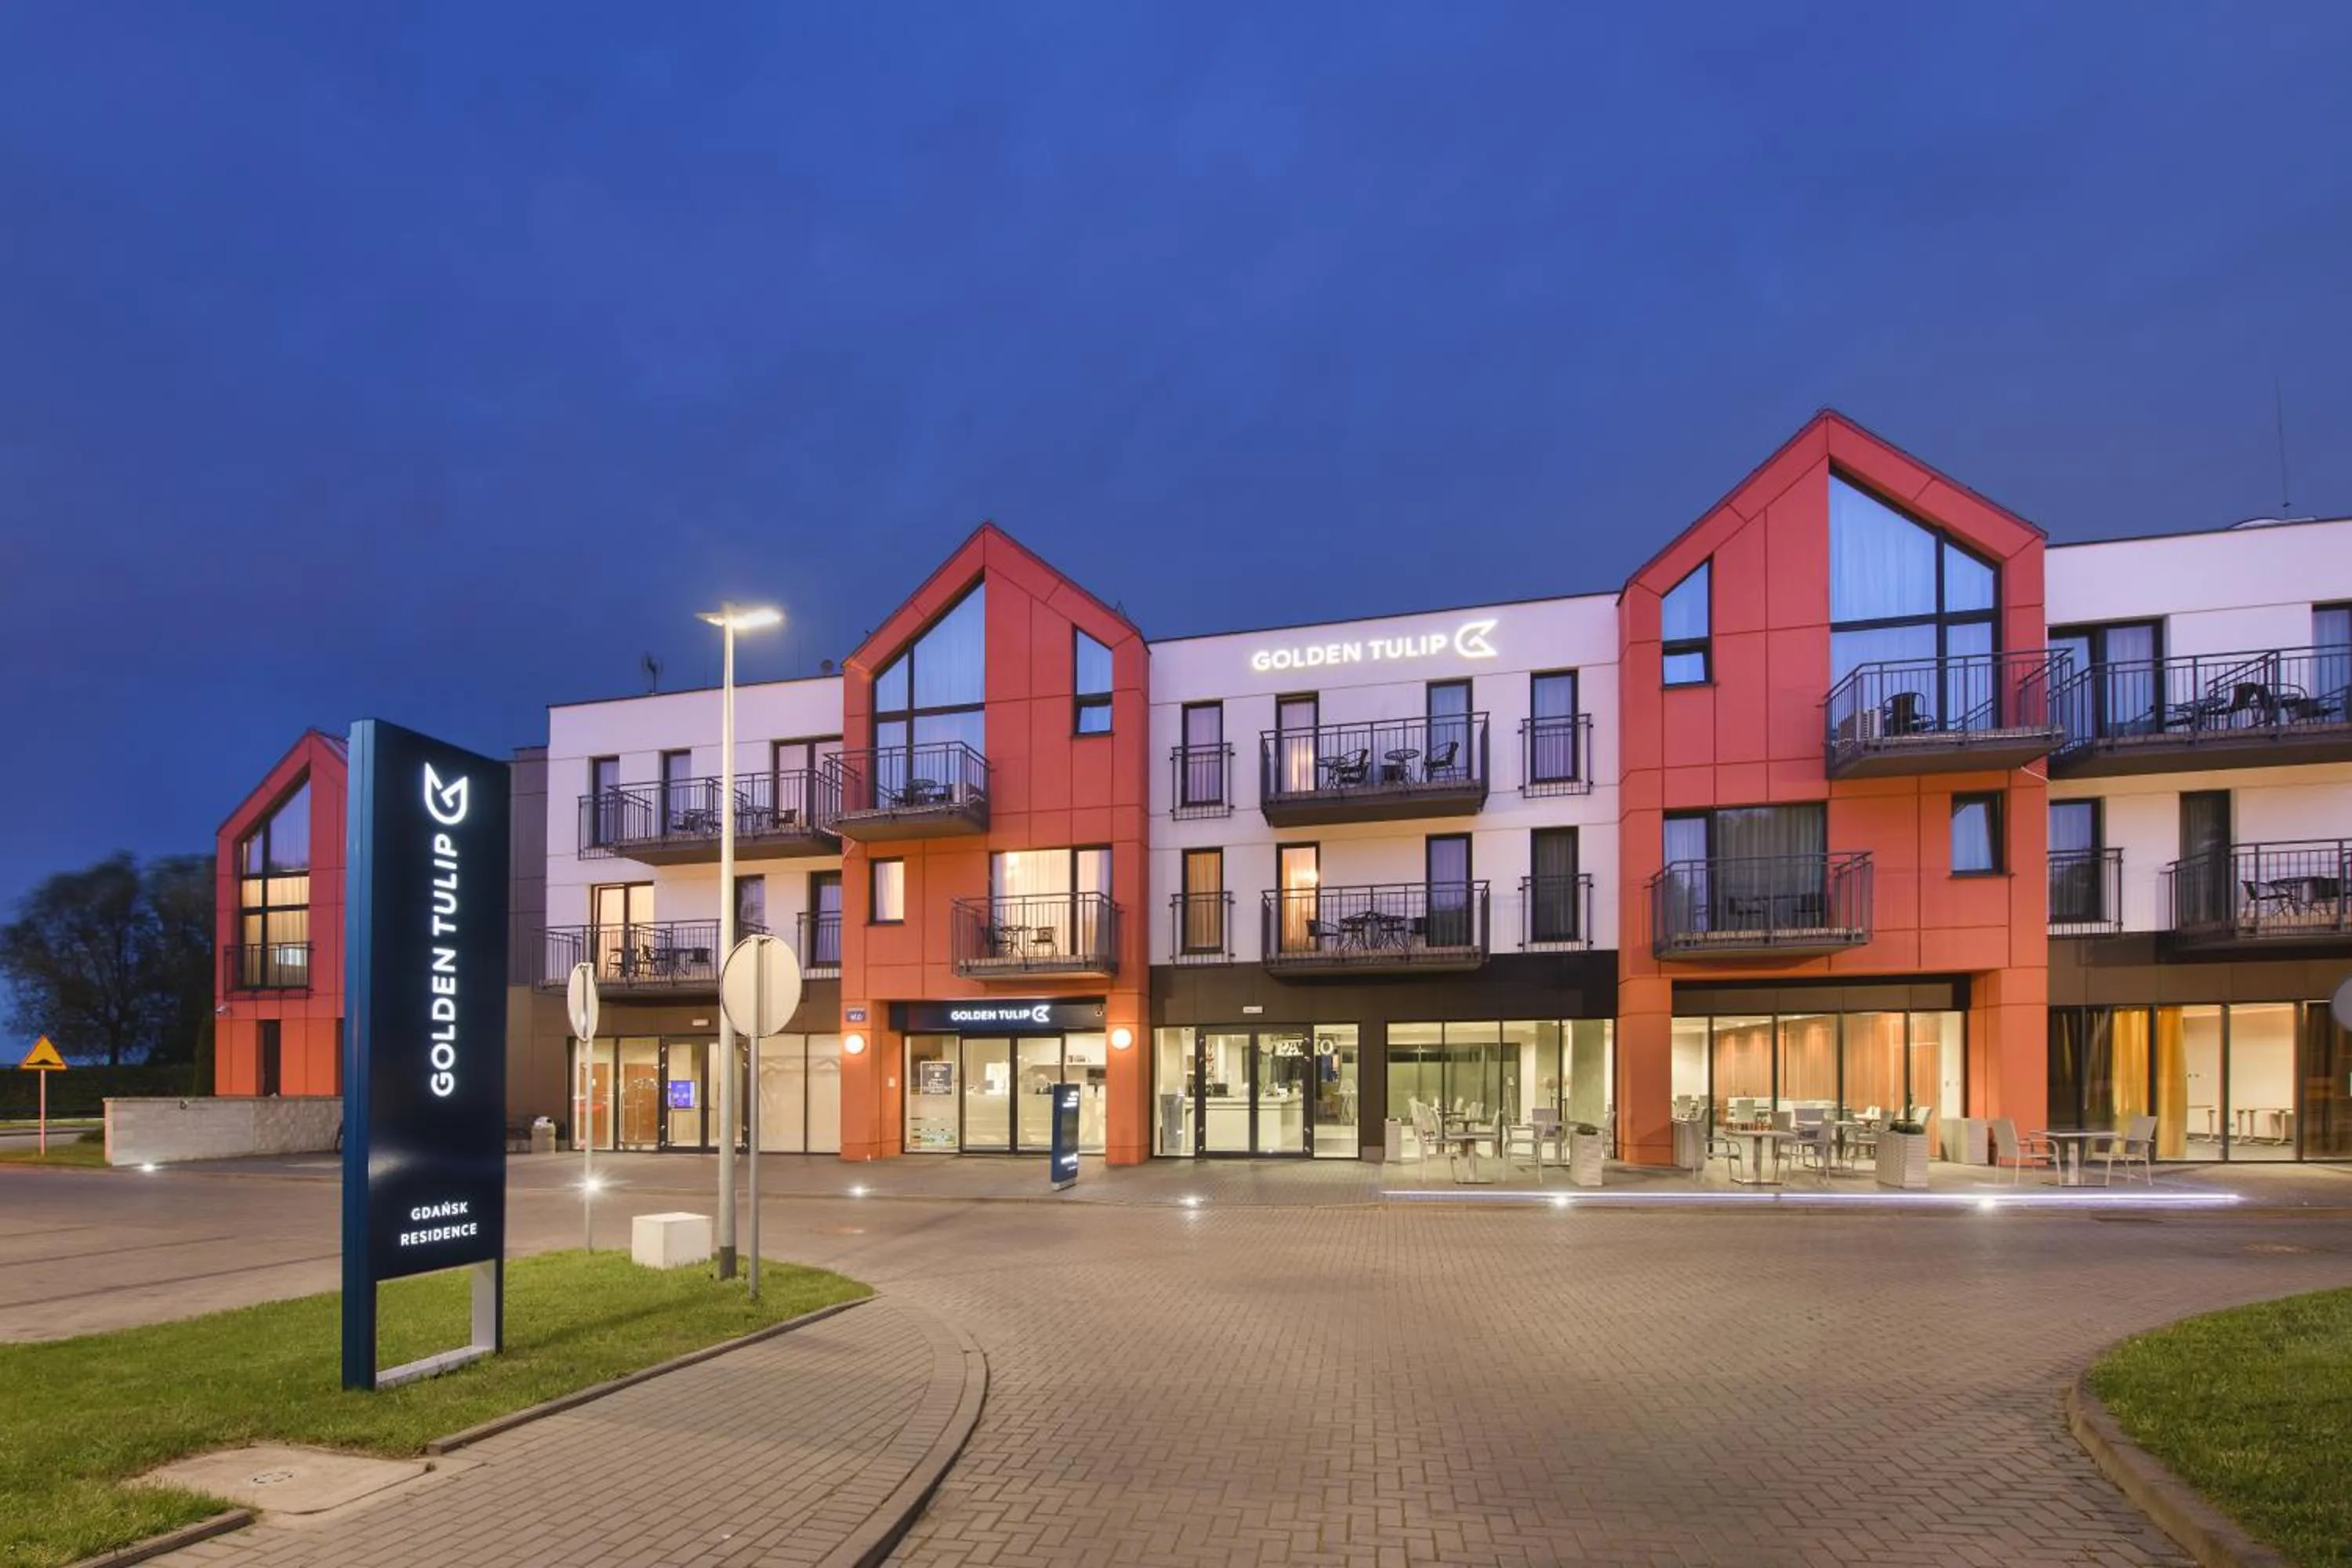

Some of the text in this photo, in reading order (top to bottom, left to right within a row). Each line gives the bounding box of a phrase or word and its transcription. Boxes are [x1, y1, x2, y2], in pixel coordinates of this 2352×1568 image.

[1253, 634, 1448, 670] GOLDEN TULIP
[430, 833, 458, 1097] GOLDEN TULIP
[951, 1008, 1030, 1021] GOLDEN TULIP
[411, 1201, 468, 1221] GDAŃSK
[401, 1222, 477, 1246] RESIDENCE
